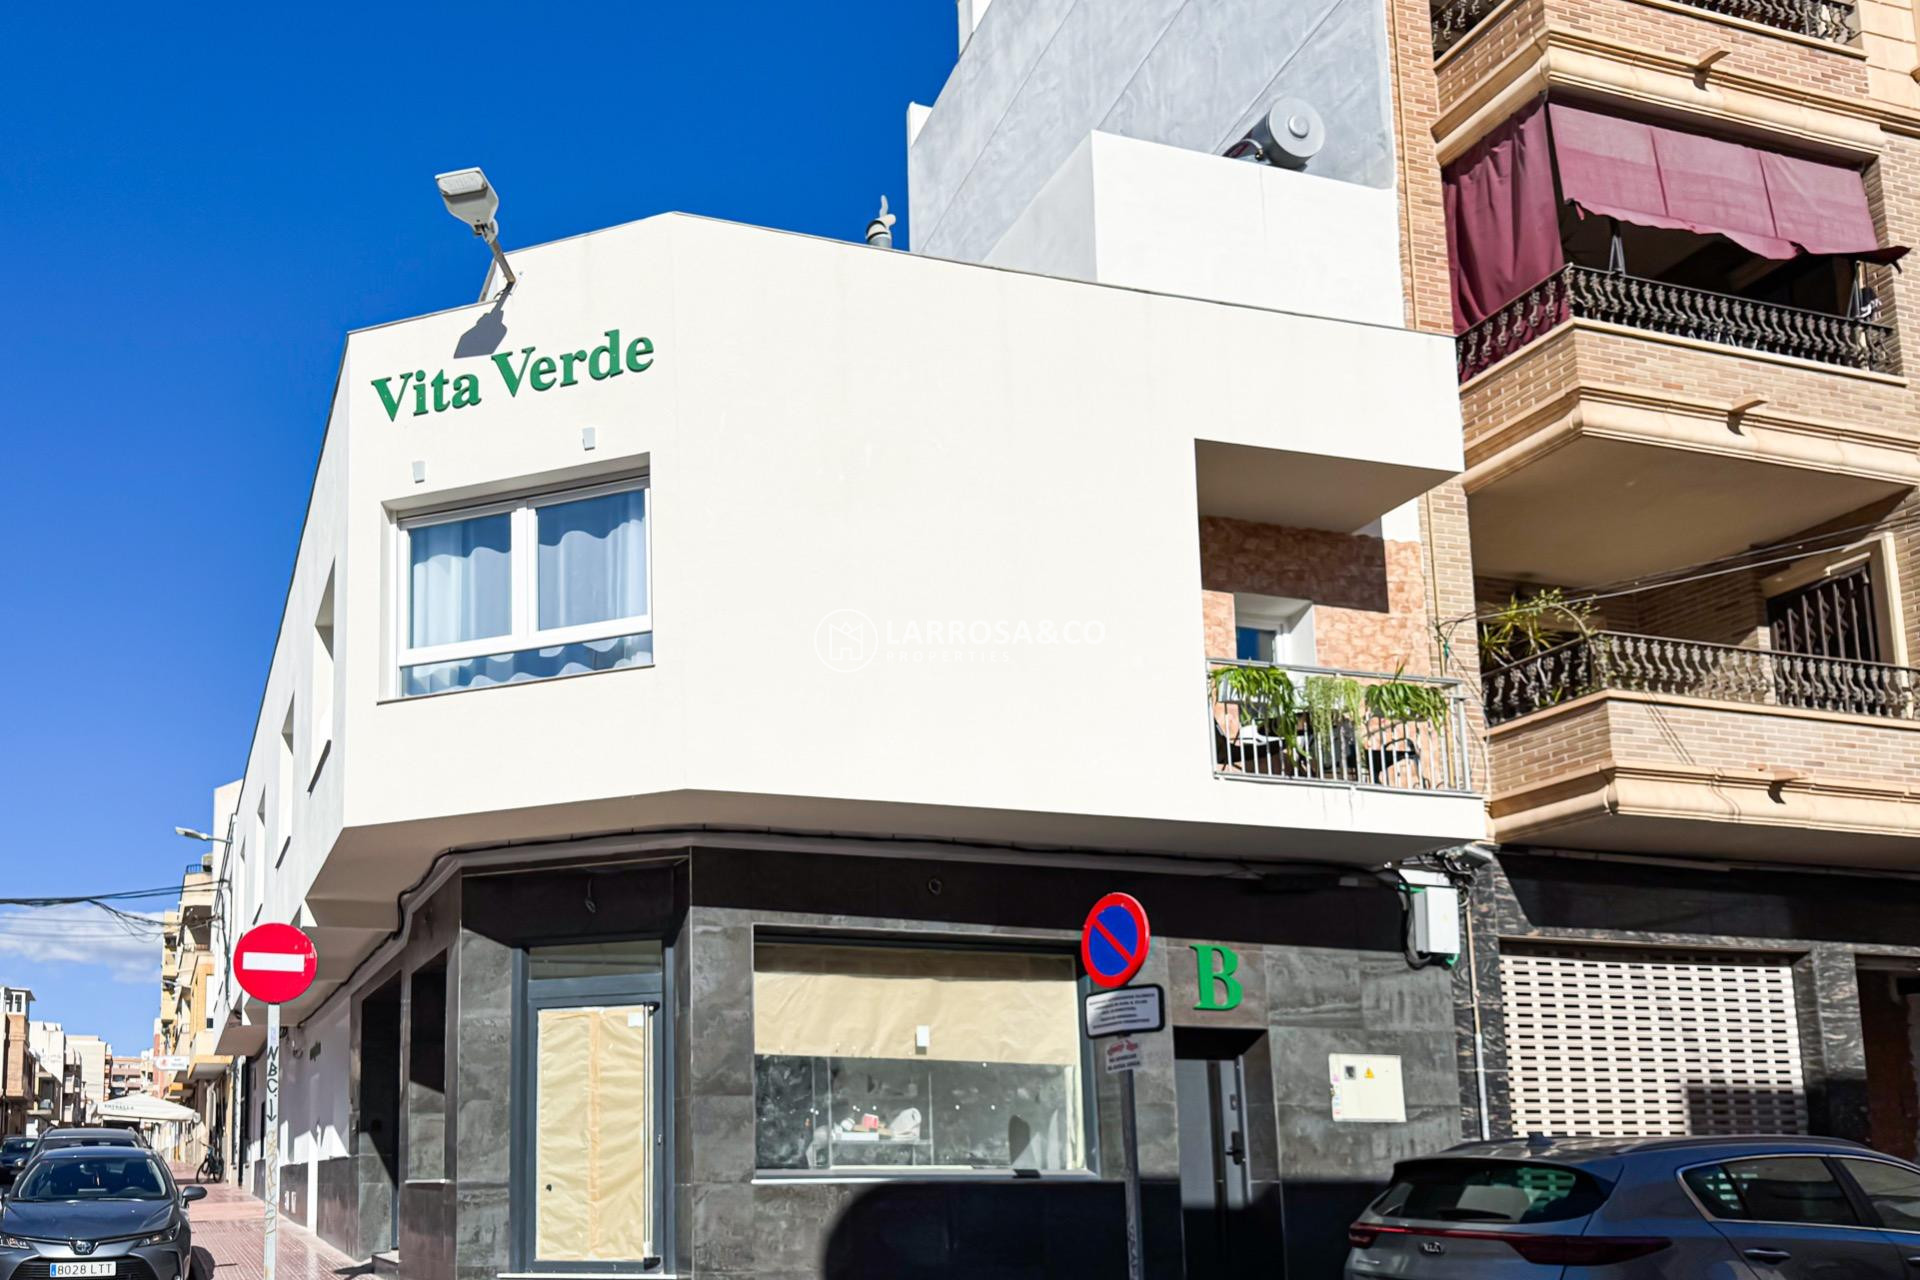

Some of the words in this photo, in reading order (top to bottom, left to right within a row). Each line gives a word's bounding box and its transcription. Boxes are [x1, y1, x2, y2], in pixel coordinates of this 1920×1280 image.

[371, 368, 482, 422] Vita
[491, 329, 654, 398] Verde
[1188, 943, 1244, 1011] B
[57, 1264, 87, 1276] 8028
[90, 1263, 112, 1275] LTT
